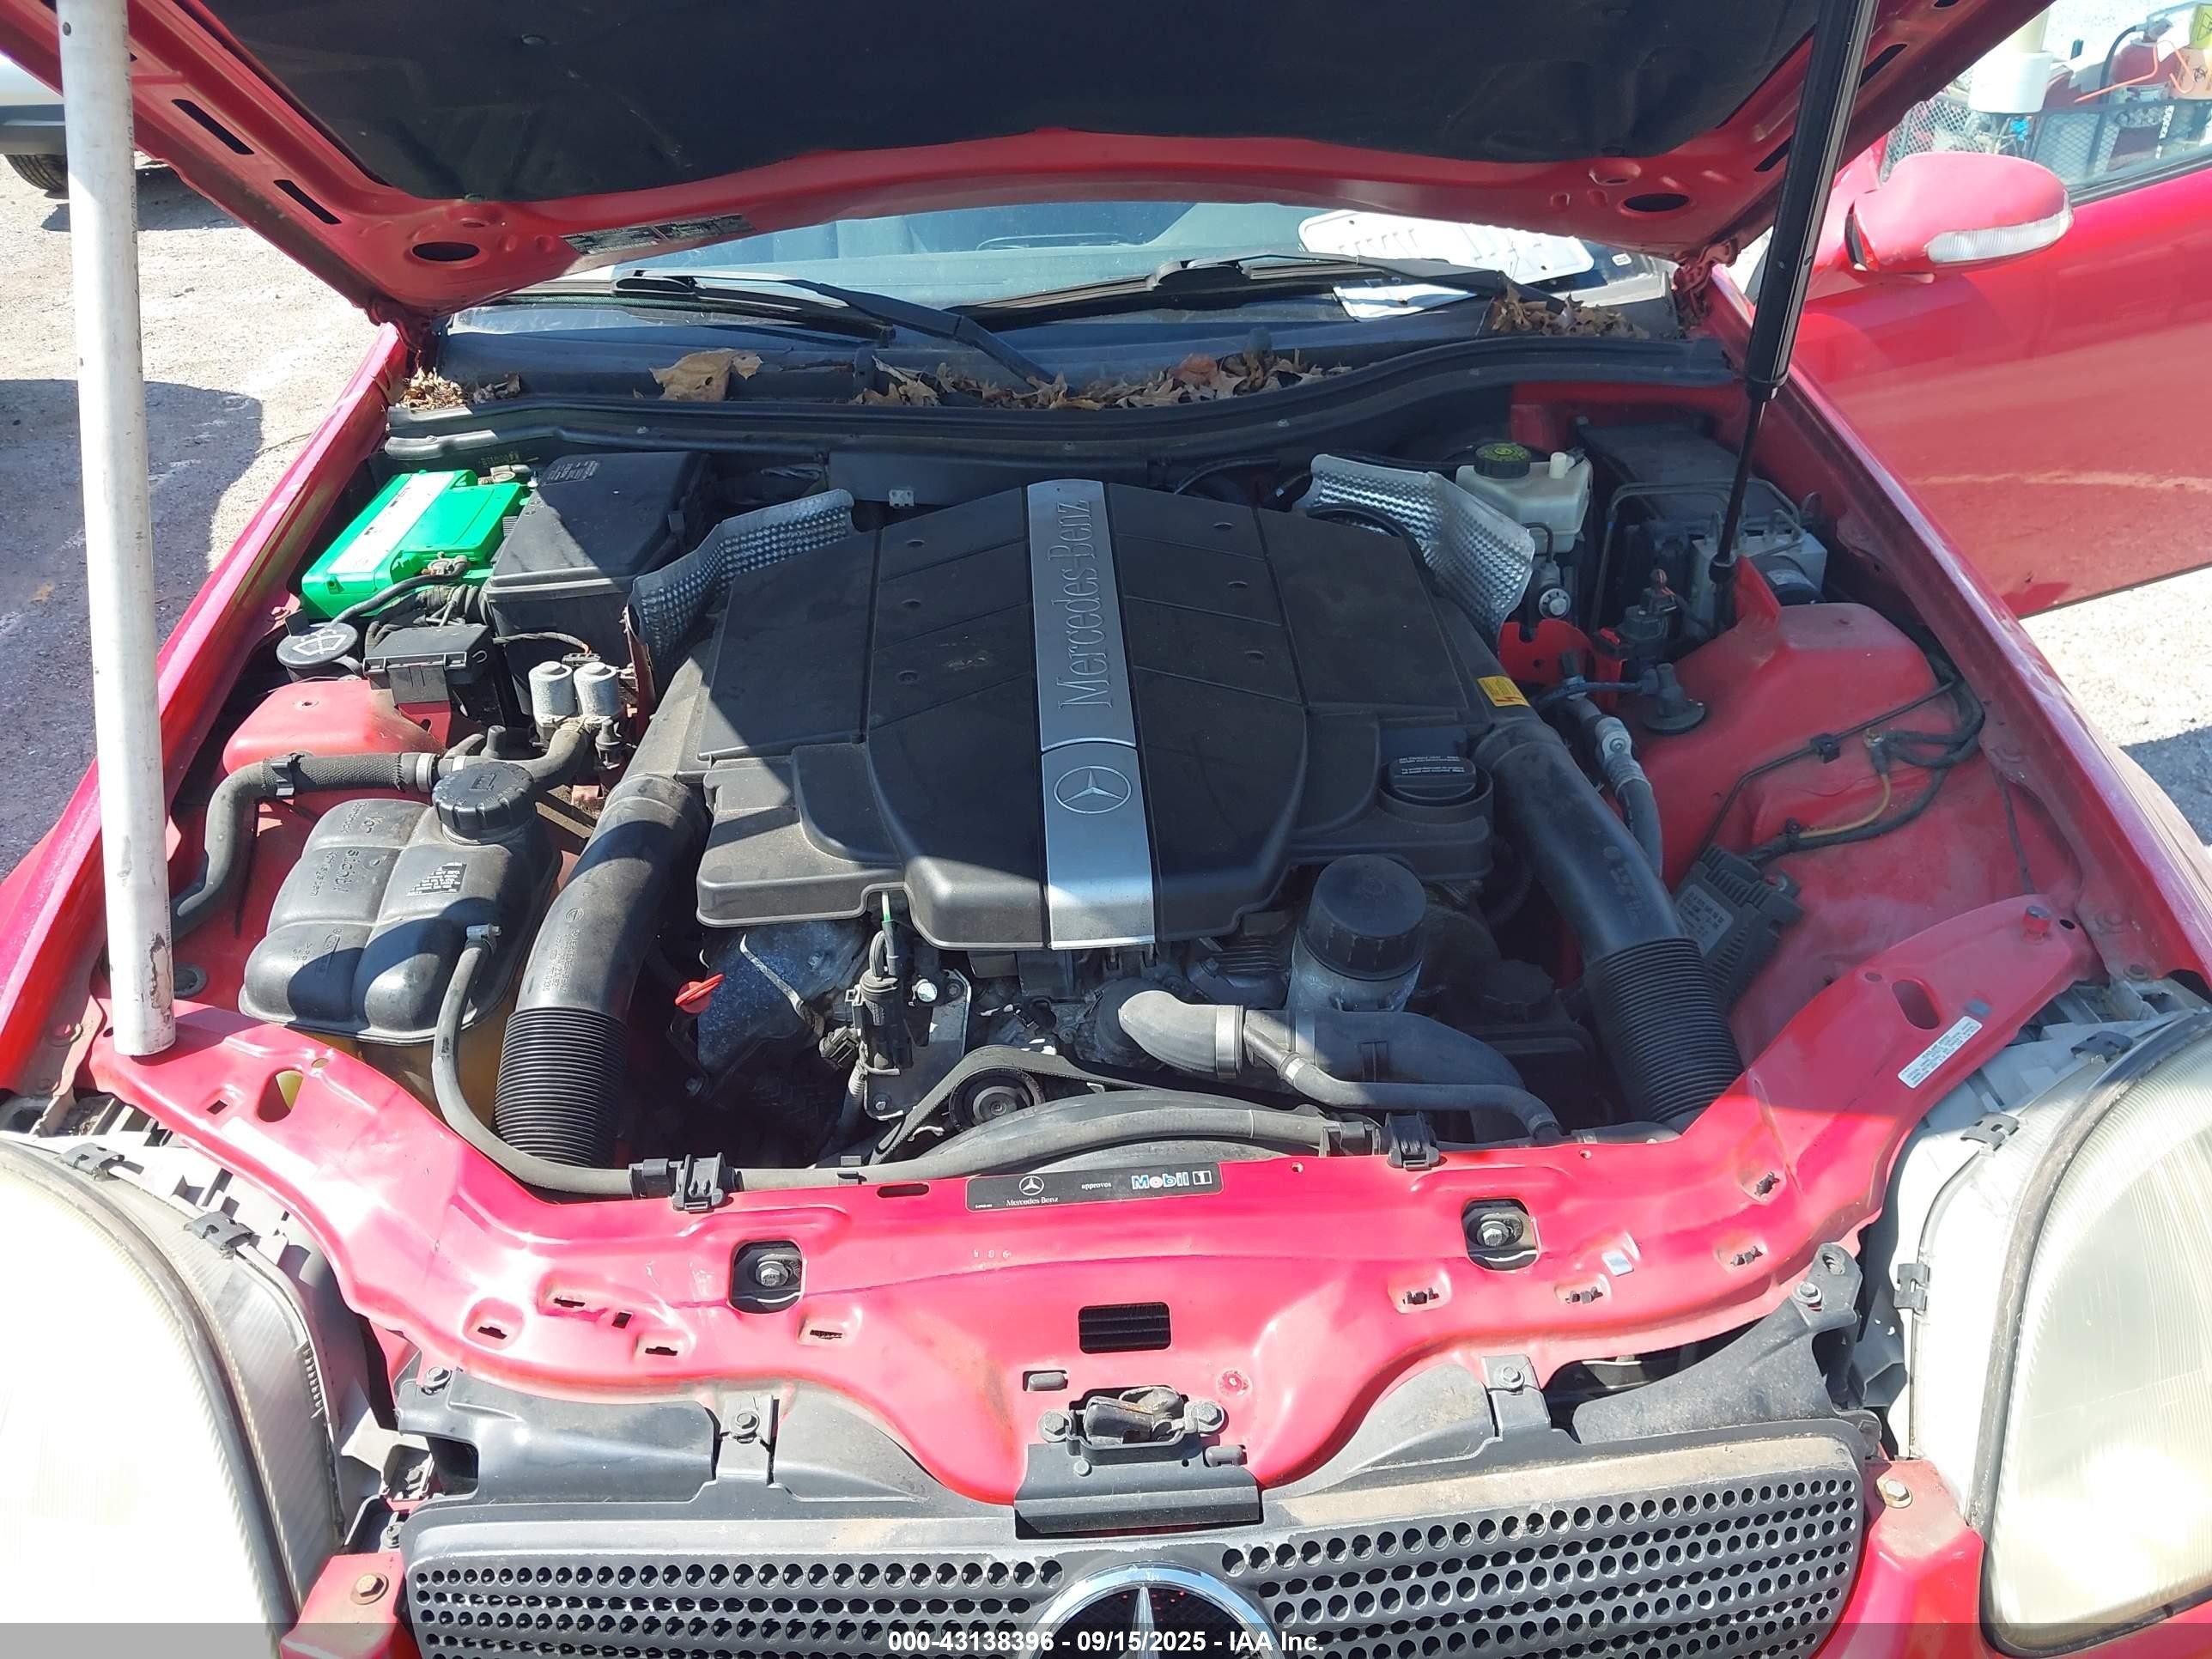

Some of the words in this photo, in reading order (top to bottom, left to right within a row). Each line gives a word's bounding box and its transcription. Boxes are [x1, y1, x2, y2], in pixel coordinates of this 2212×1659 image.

[1048, 500, 1113, 708] Mercedes-Benz
[1081, 1182, 1112, 1190] approves
[1131, 1171, 1189, 1190] Mobil
[1006, 1198, 1040, 1207] Mercedes
